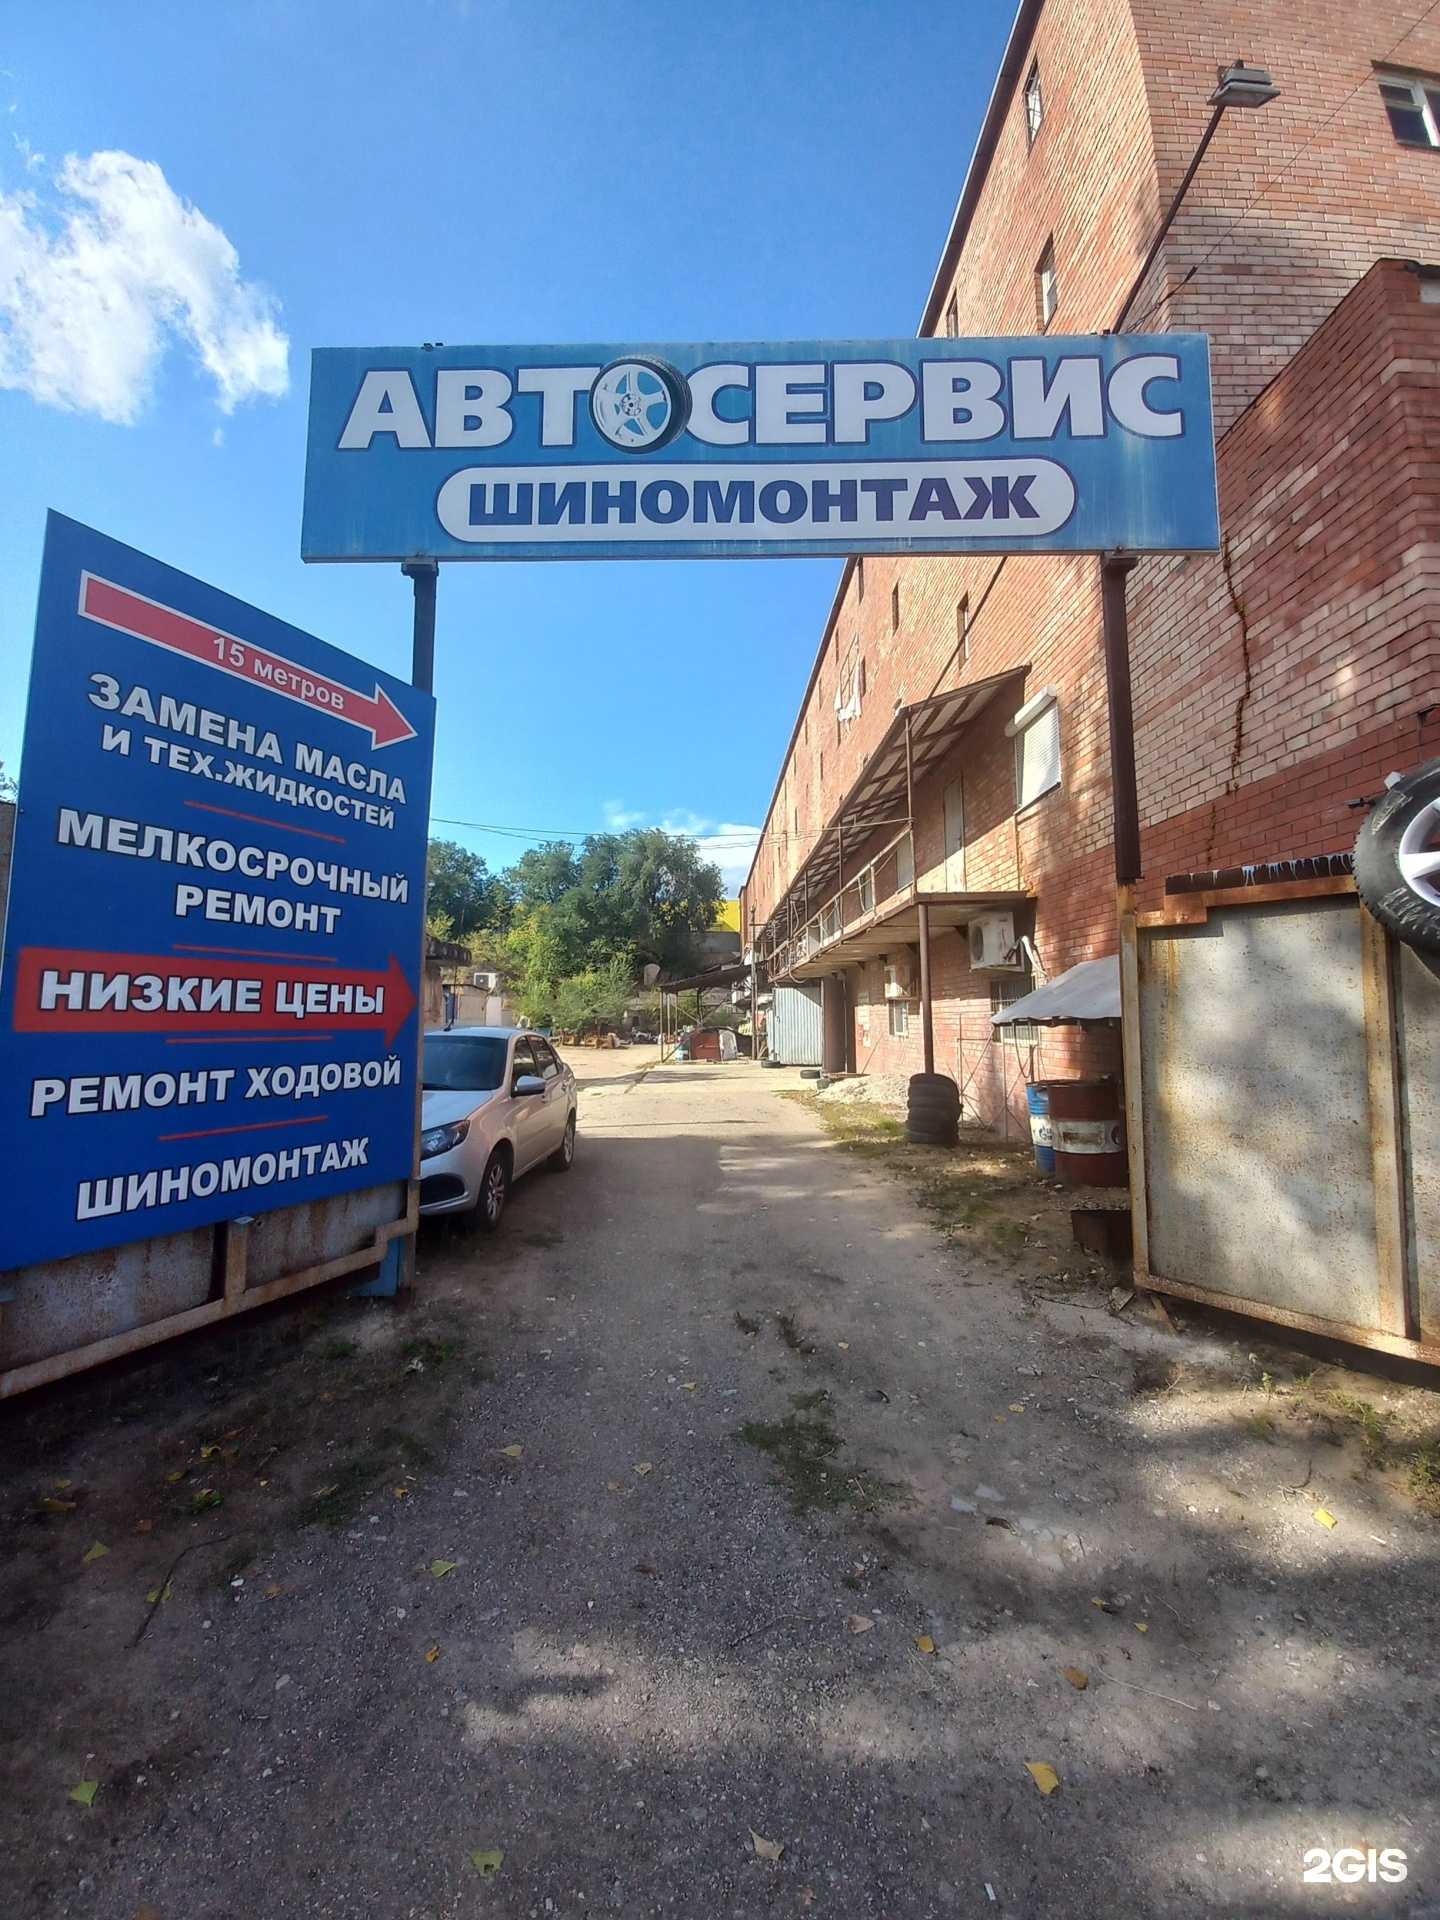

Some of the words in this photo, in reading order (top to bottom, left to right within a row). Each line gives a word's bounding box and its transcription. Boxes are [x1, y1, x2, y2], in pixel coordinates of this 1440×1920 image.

[468, 474, 1041, 527] ШИНОМОНТАЖ
[213, 635, 245, 668] 15
[253, 661, 344, 711] метров
[87, 672, 283, 765] ЗАМЕНА
[294, 741, 408, 804] МАСЛА
[100, 725, 131, 756] И
[56, 807, 409, 904] МЕЛКОСРОЧНЫЙ
[174, 884, 342, 935] РЕМОНТ
[38, 969, 263, 1013] НИЗКИЕ
[274, 980, 385, 1019] ЦЕНЫ
[29, 1069, 235, 1118] РЕМОНТ
[244, 1054, 402, 1100] ХОДОВОЙ
[76, 1136, 370, 1221] ШИНОМОНТАЖ
